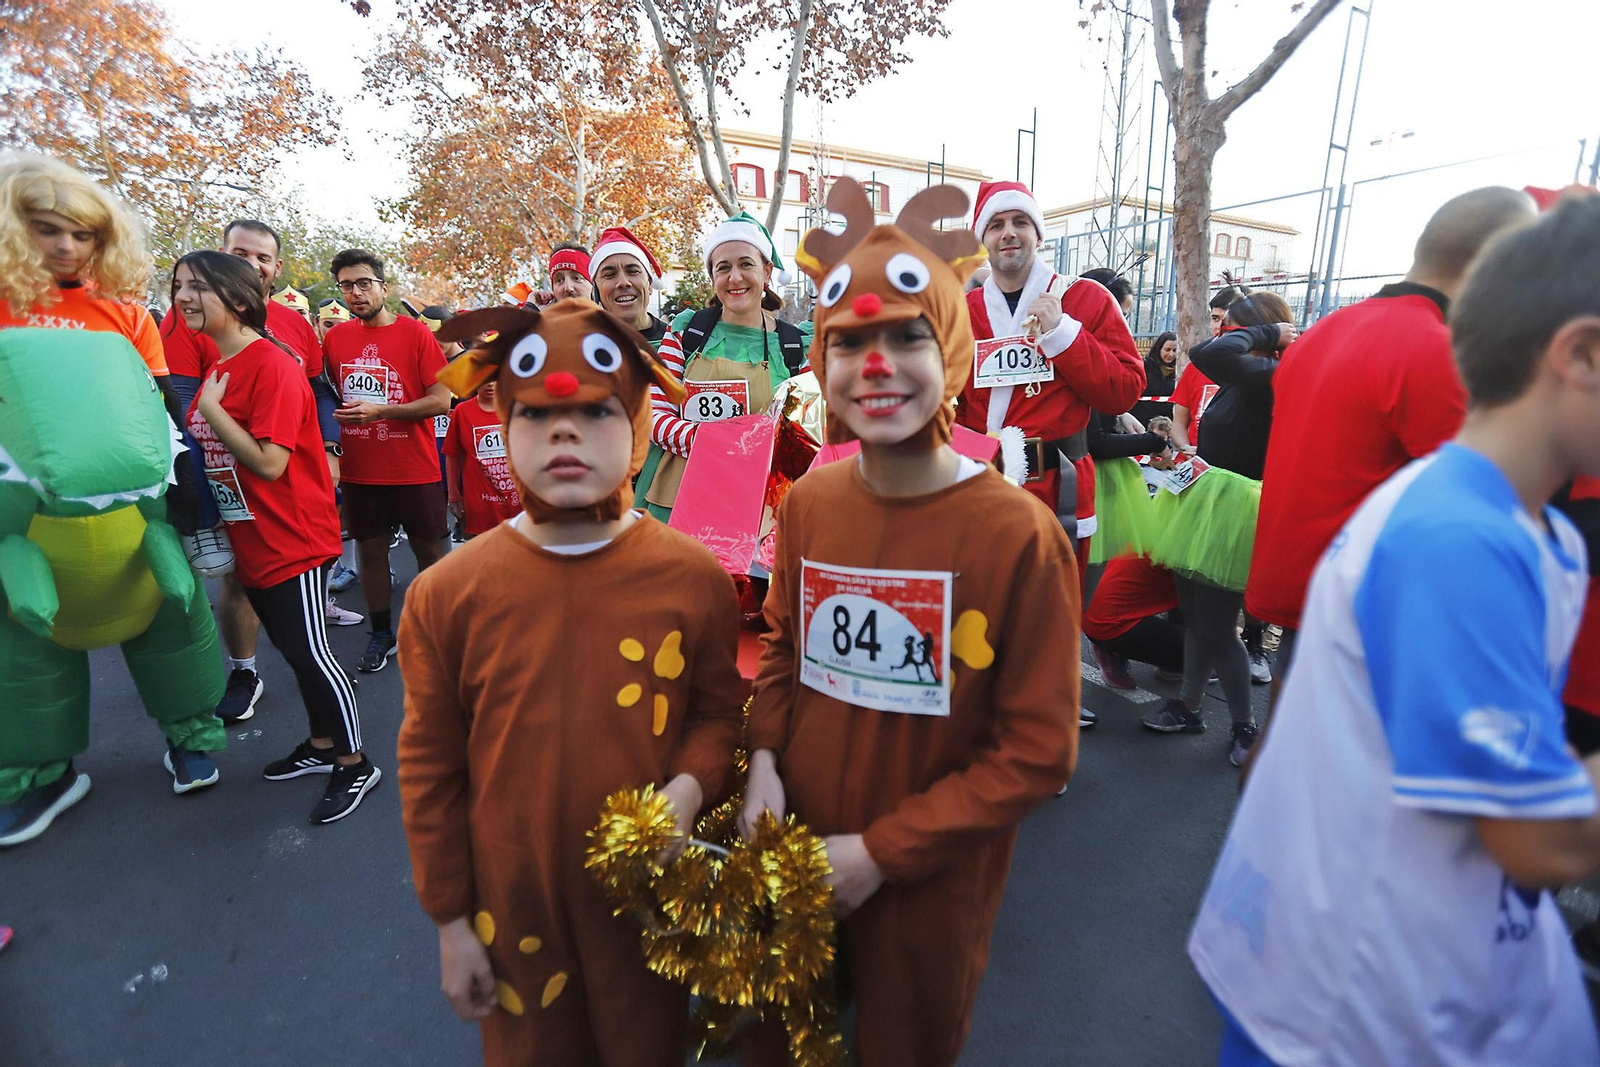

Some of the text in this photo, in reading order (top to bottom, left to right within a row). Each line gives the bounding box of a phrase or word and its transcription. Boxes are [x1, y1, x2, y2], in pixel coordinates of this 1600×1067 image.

[994, 347, 1032, 369] 103
[348, 375, 373, 391] 340
[698, 396, 724, 418] 83
[485, 433, 505, 448] 61
[491, 478, 515, 491] 202
[833, 605, 881, 661] 84
